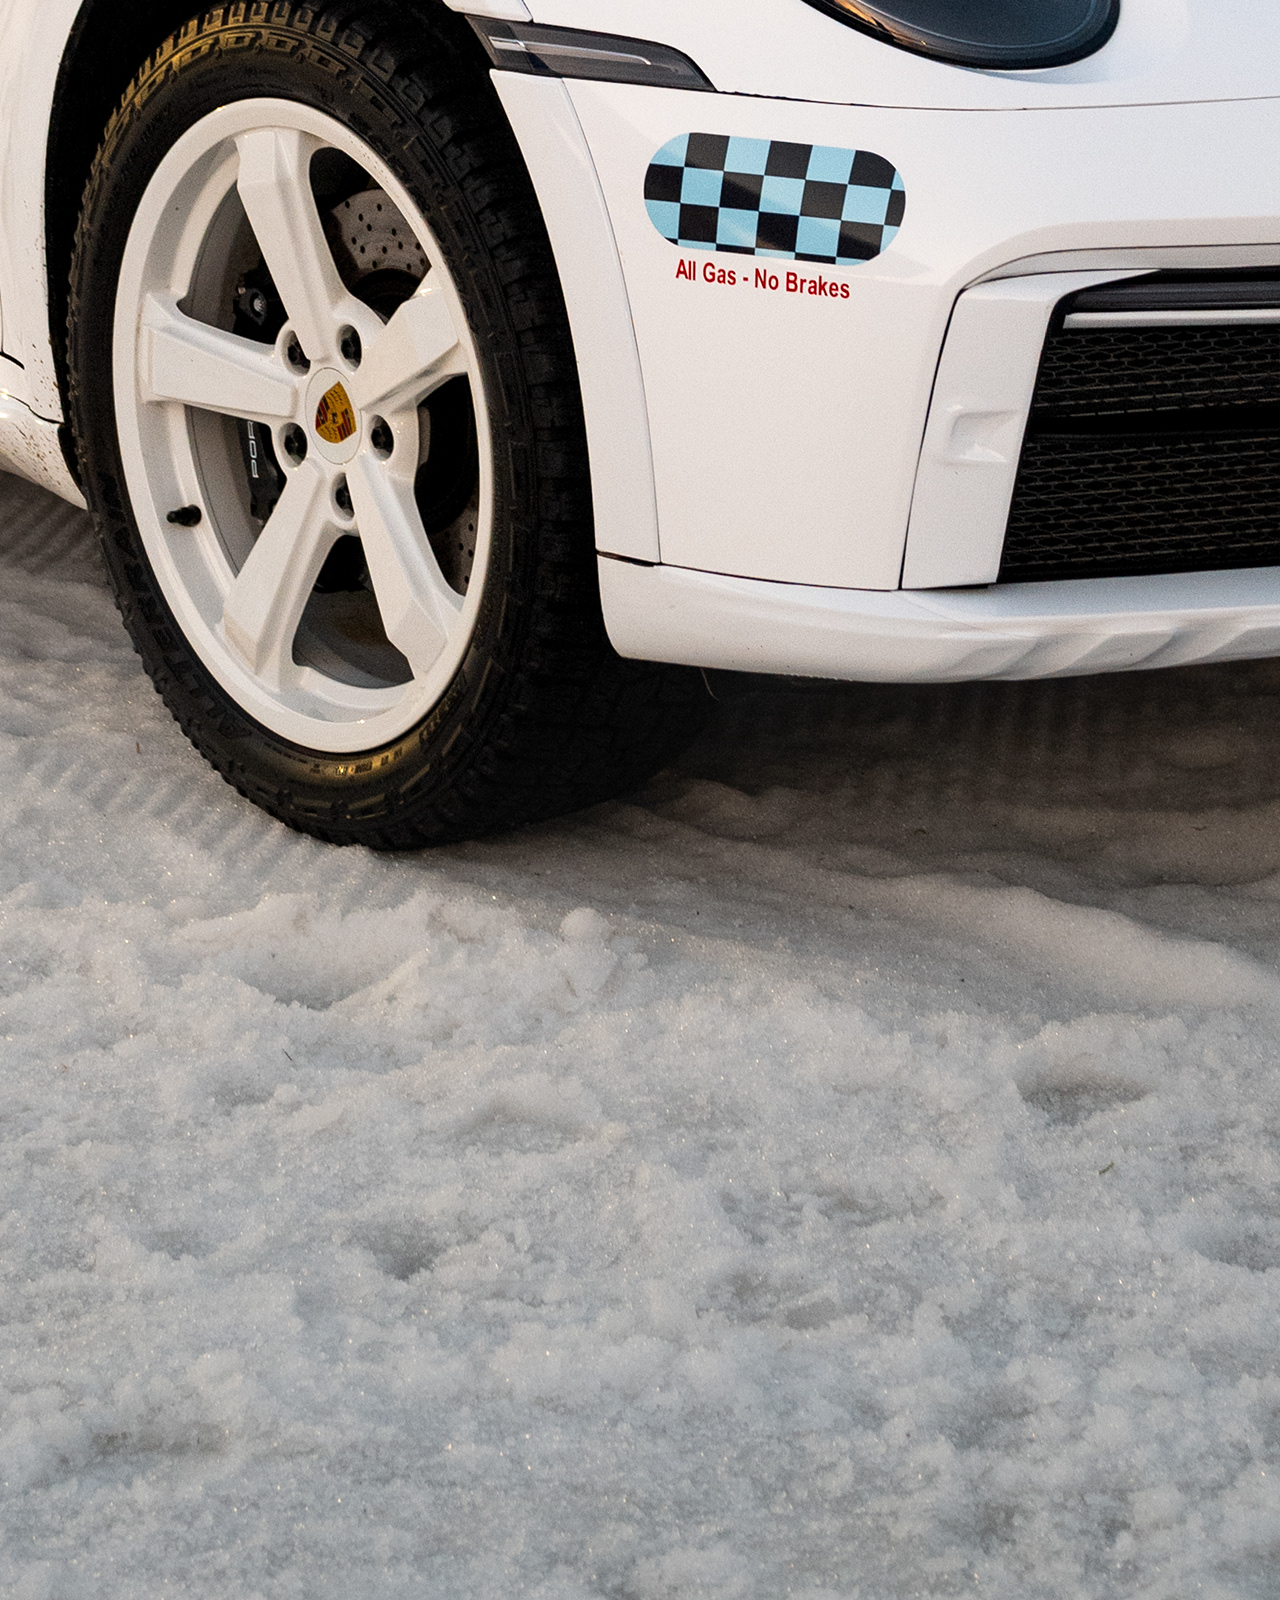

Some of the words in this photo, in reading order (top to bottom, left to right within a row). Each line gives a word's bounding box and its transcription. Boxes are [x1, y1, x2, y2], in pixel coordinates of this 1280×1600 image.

[675, 258, 697, 281] All
[702, 261, 737, 286] Gas
[754, 267, 779, 291] No
[785, 271, 851, 299] Brakes
